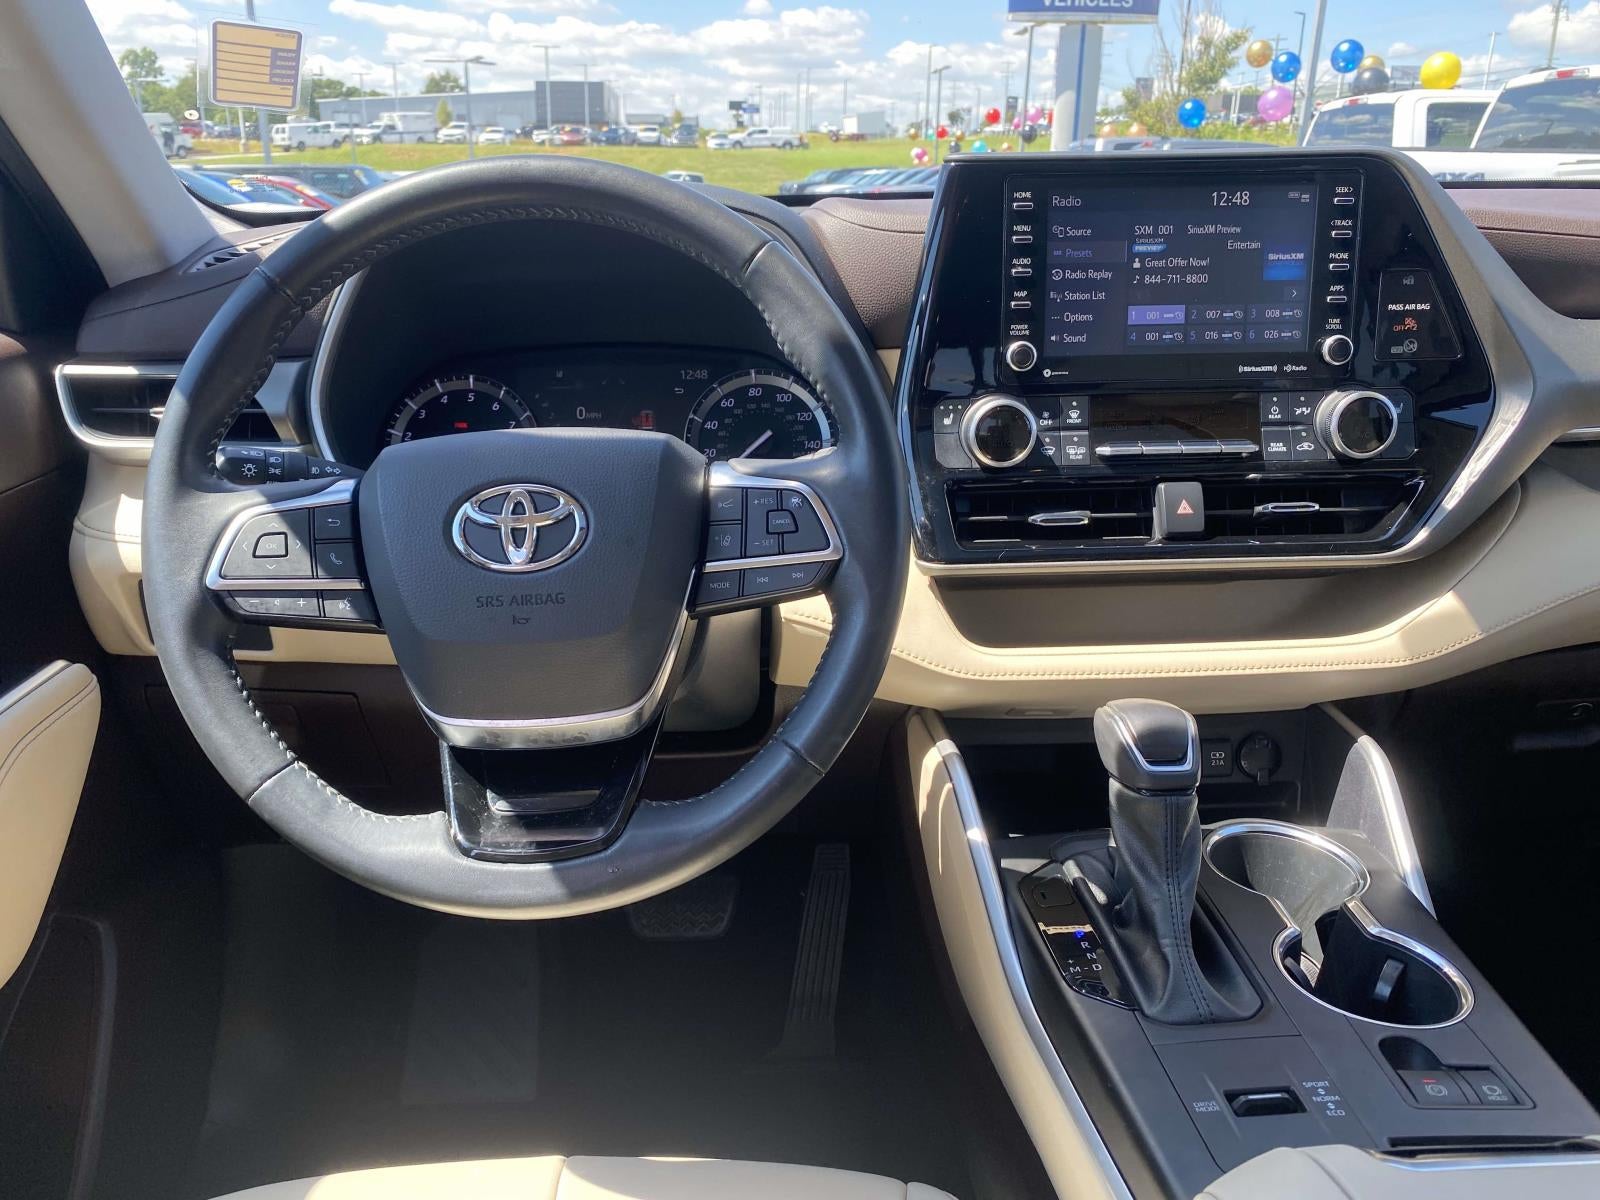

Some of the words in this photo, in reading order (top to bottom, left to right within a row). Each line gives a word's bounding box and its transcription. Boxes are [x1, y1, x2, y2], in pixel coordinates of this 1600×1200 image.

[1013, 191, 1032, 199] HOME
[1211, 191, 1250, 206] 12:48
[1052, 195, 1082, 207] Radio
[1066, 226, 1092, 237] Source
[1134, 225, 1153, 235] SXM
[1158, 225, 1174, 235] 001
[1187, 224, 1215, 234] SiriusXM
[1216, 225, 1242, 234] Preview
[1227, 239, 1261, 250] Entertain
[1065, 248, 1093, 258] Presets
[1329, 252, 1349, 260] PHONE
[1145, 257, 1166, 268] Great
[1167, 257, 1188, 267] Offer
[1189, 257, 1210, 267] Now!
[1065, 269, 1086, 279] Radio
[1088, 269, 1113, 281] Replay
[1144, 274, 1209, 285] 844-711-8800
[1013, 290, 1028, 298] MAP
[1064, 290, 1091, 301] Station
[1092, 290, 1106, 300] List
[1388, 303, 1404, 311] PASS
[1063, 312, 1093, 323] Options
[1131, 311, 1136, 321] 1
[1146, 311, 1160, 320] 001
[1191, 309, 1197, 319] 2
[1206, 310, 1221, 319] 007
[1250, 309, 1256, 319] 3
[1265, 309, 1280, 318] 008
[1063, 334, 1087, 343] Sound
[1130, 333, 1136, 342] 4
[1145, 332, 1159, 341] 001
[1190, 331, 1196, 340] 5
[1204, 331, 1219, 340] 016
[1249, 330, 1255, 339] 6
[1264, 330, 1279, 339] 026
[680, 369, 708, 380] 12:48
[748, 387, 762, 397] 80
[440, 395, 448, 404] 4
[467, 393, 475, 402] 5
[720, 398, 735, 407] 60
[775, 393, 792, 402] 100
[492, 402, 500, 411] 6
[418, 409, 426, 419] 3
[576, 406, 586, 420] 0
[797, 412, 812, 421] 120
[508, 421, 516, 429] 7
[704, 420, 719, 430] 40
[404, 432, 412, 441] 2
[803, 440, 821, 449] 140
[704, 448, 717, 458] 20
[761, 538, 774, 546] SET
[476, 596, 504, 608] SRS
[508, 592, 566, 607] AIRBAG
[1080, 941, 1091, 949] R
[1086, 952, 1097, 960] N
[1092, 963, 1102, 971] D
